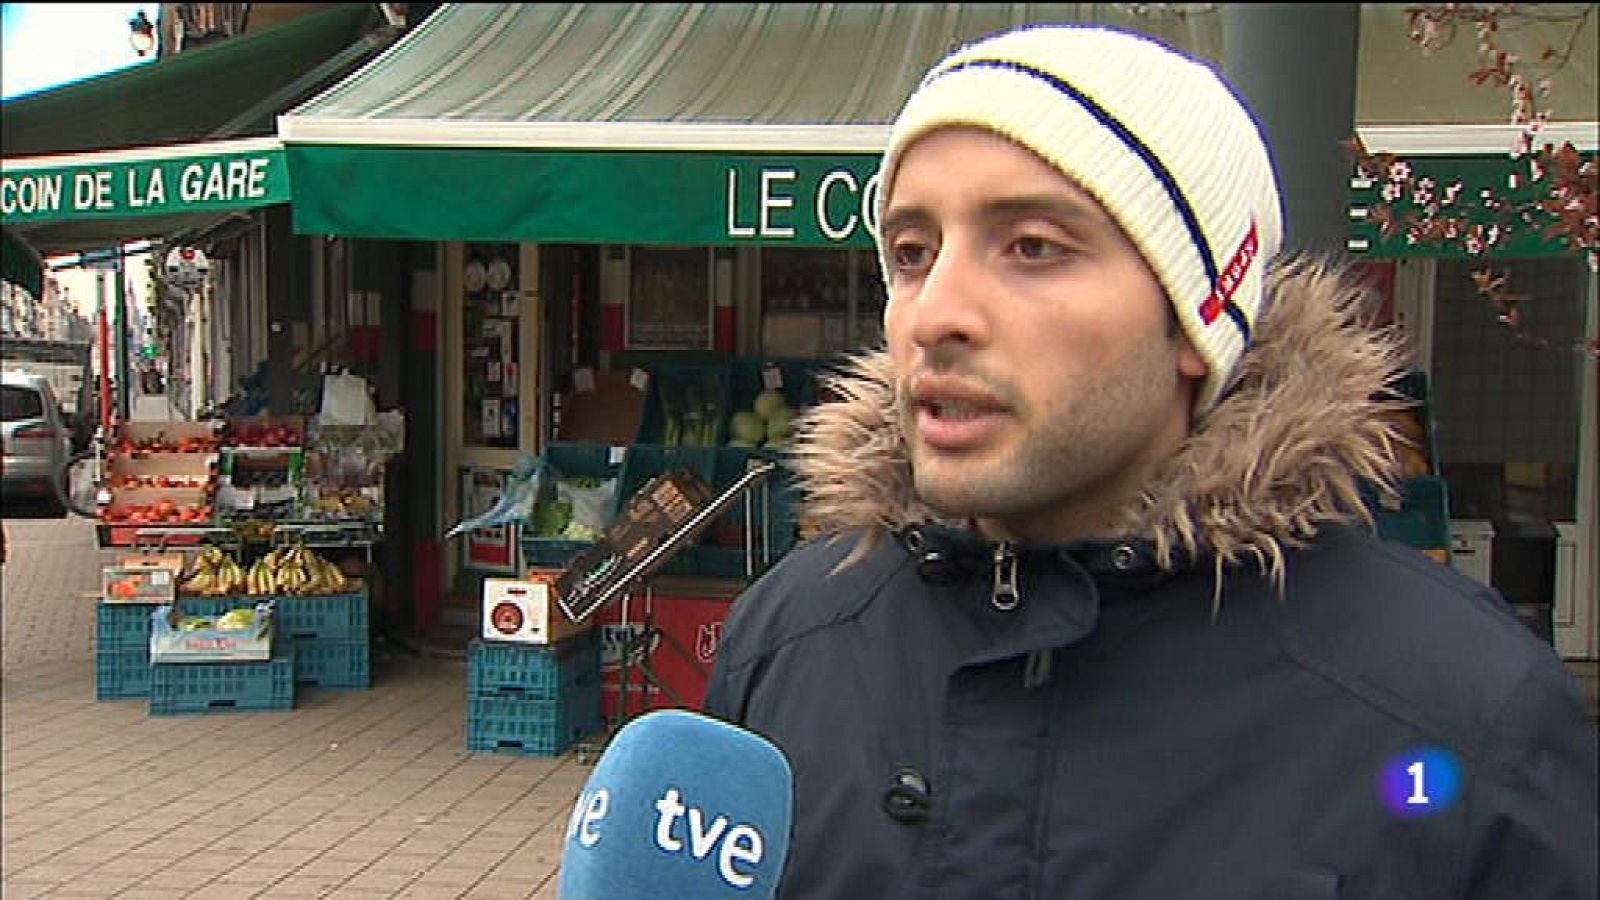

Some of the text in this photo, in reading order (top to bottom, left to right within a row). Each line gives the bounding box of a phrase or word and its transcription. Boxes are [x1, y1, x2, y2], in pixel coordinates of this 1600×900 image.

[1, 158, 270, 214] COIN DE LA GARE
[727, 168, 796, 238] LE
[655, 787, 763, 887] tve
